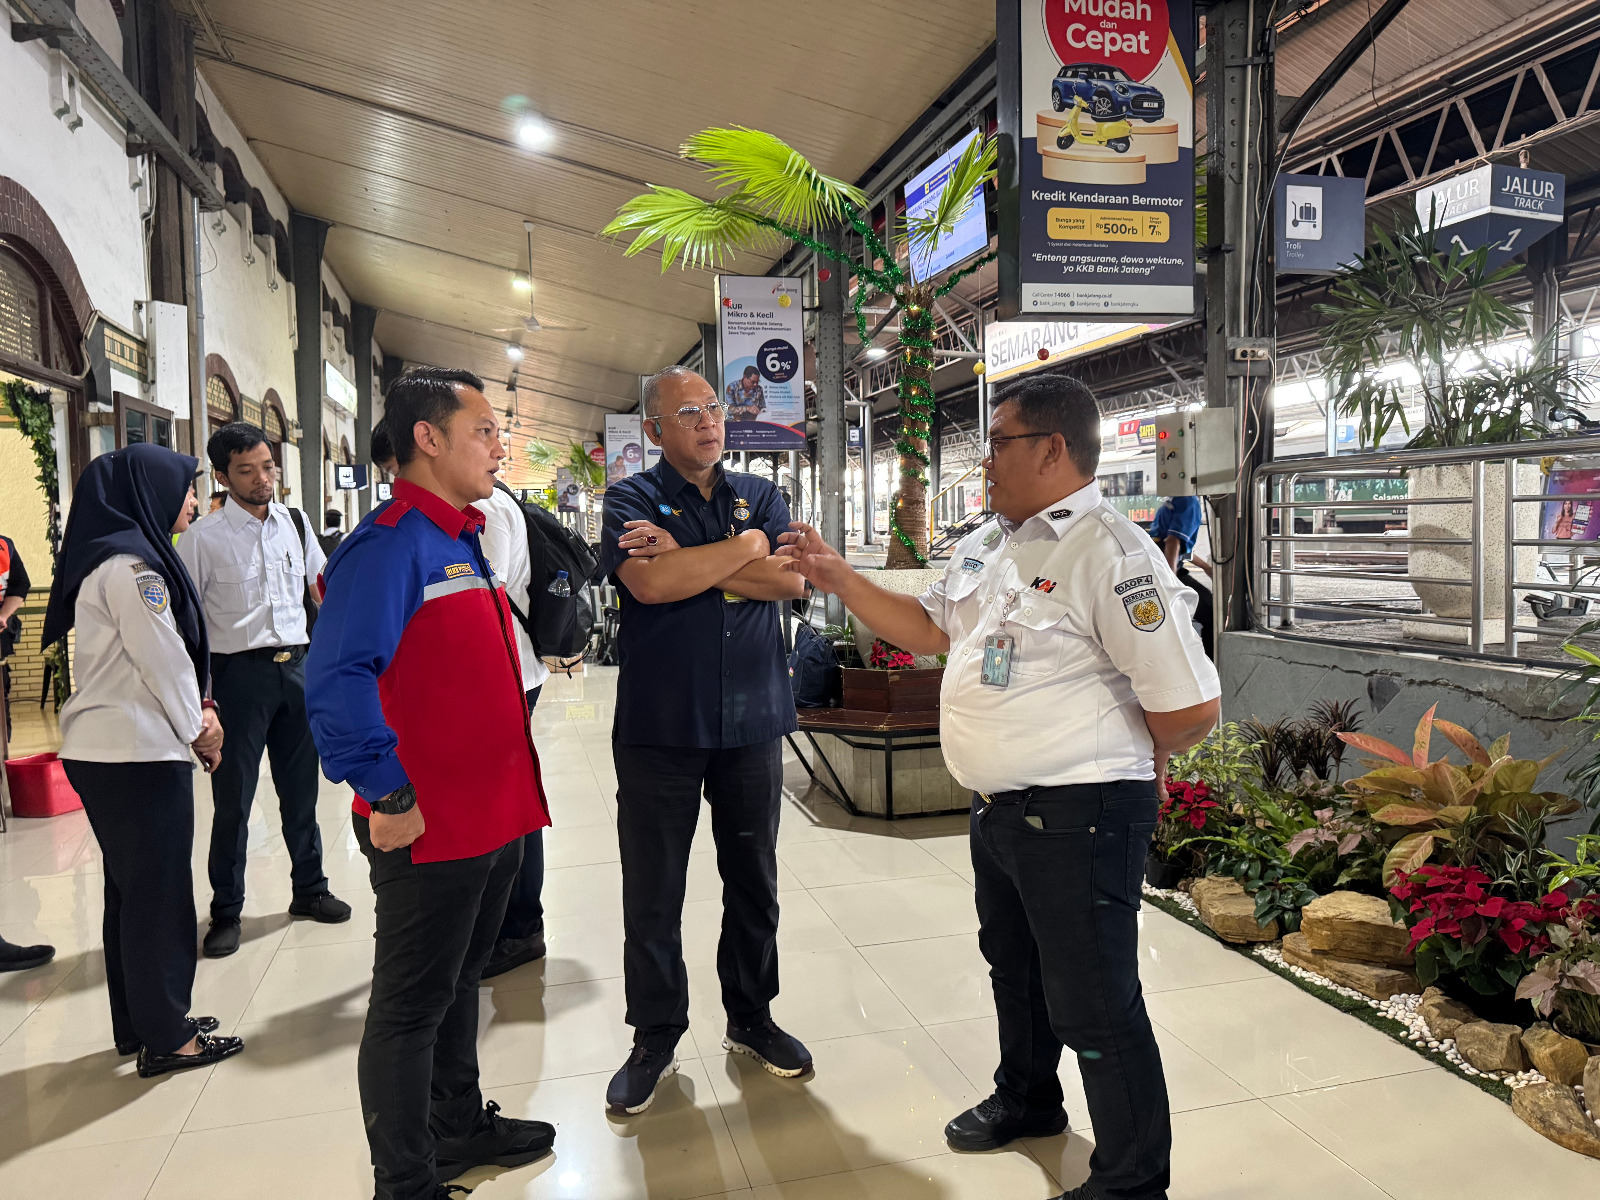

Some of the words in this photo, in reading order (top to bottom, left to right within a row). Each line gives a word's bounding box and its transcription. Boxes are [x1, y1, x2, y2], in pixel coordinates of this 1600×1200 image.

[1064, 0, 1152, 21] Mudah
[1099, 19, 1118, 30] dan
[1066, 22, 1150, 57] Cepat
[1501, 175, 1555, 199] JALUR
[1031, 190, 1067, 202] Kredit
[1069, 191, 1129, 204] Kendaraan
[1132, 194, 1184, 207] Bermotor
[1513, 196, 1545, 211] TRACK
[1285, 241, 1302, 250] Troli
[1450, 234, 1474, 256] 1
[1498, 228, 1522, 251] 1
[1069, 255, 1119, 265] angsurane,
[1120, 255, 1144, 264] dowo
[1145, 256, 1185, 266] wektune,
[1286, 250, 1305, 259] Trolley
[1062, 265, 1075, 274] yo
[1075, 264, 1095, 273] KKB
[1096, 265, 1120, 274] Bank
[990, 321, 1080, 368] SEMARANG
[1029, 576, 1058, 593] KAI
[1117, 578, 1143, 592] DAOP
[1144, 576, 1151, 584] 4
